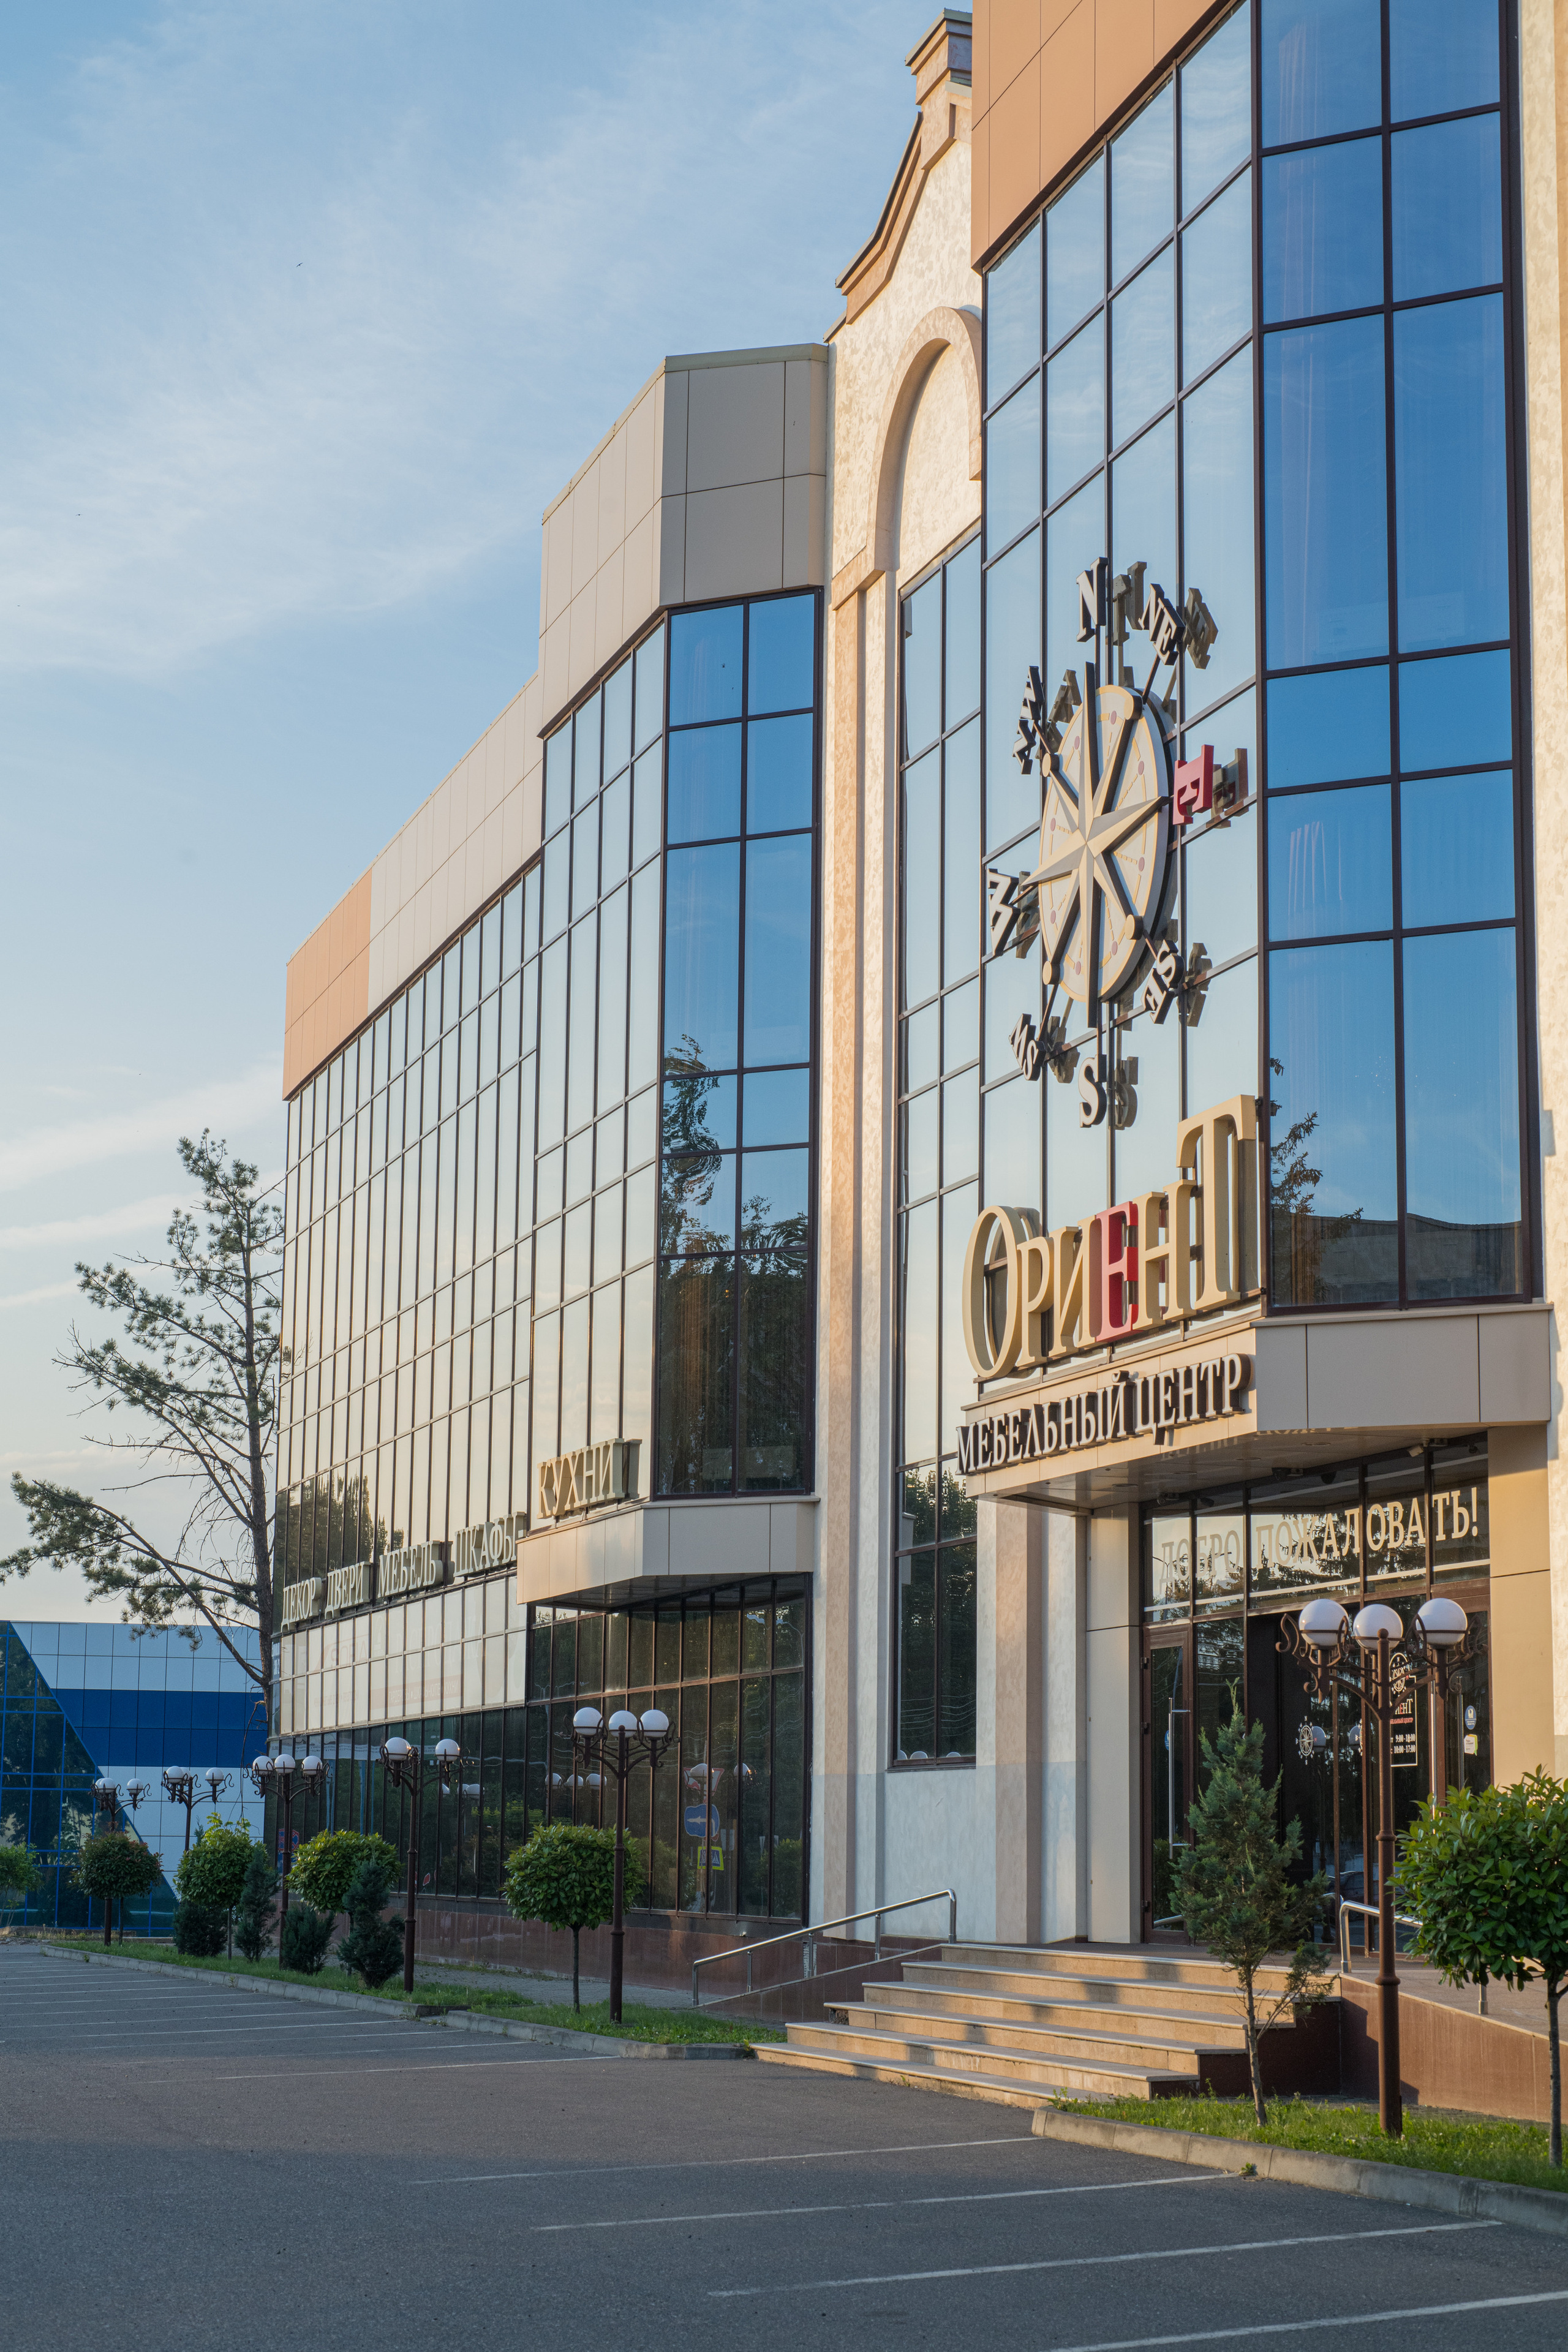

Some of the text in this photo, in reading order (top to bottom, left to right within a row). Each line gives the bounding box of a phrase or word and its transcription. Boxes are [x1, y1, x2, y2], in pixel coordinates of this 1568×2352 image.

[1077, 557, 1107, 643] N
[1139, 583, 1185, 666] NE
[1173, 745, 1214, 825] E
[1079, 1054, 1107, 1128] S
[962, 1094, 1256, 1378] ОРИЕНТ
[955, 1352, 1251, 1475] МЕБЕЛЬНЫЙ ЦЕНТР
[537, 1438, 625, 1519] КУХНИ
[281, 1511, 526, 1632] ДЕКОР ДВЕРИ МЕБЕЛЬ ШКАФЫ
[1159, 1487, 1479, 1594] ДОБРО ПОЖАЛОВАТЬ!
